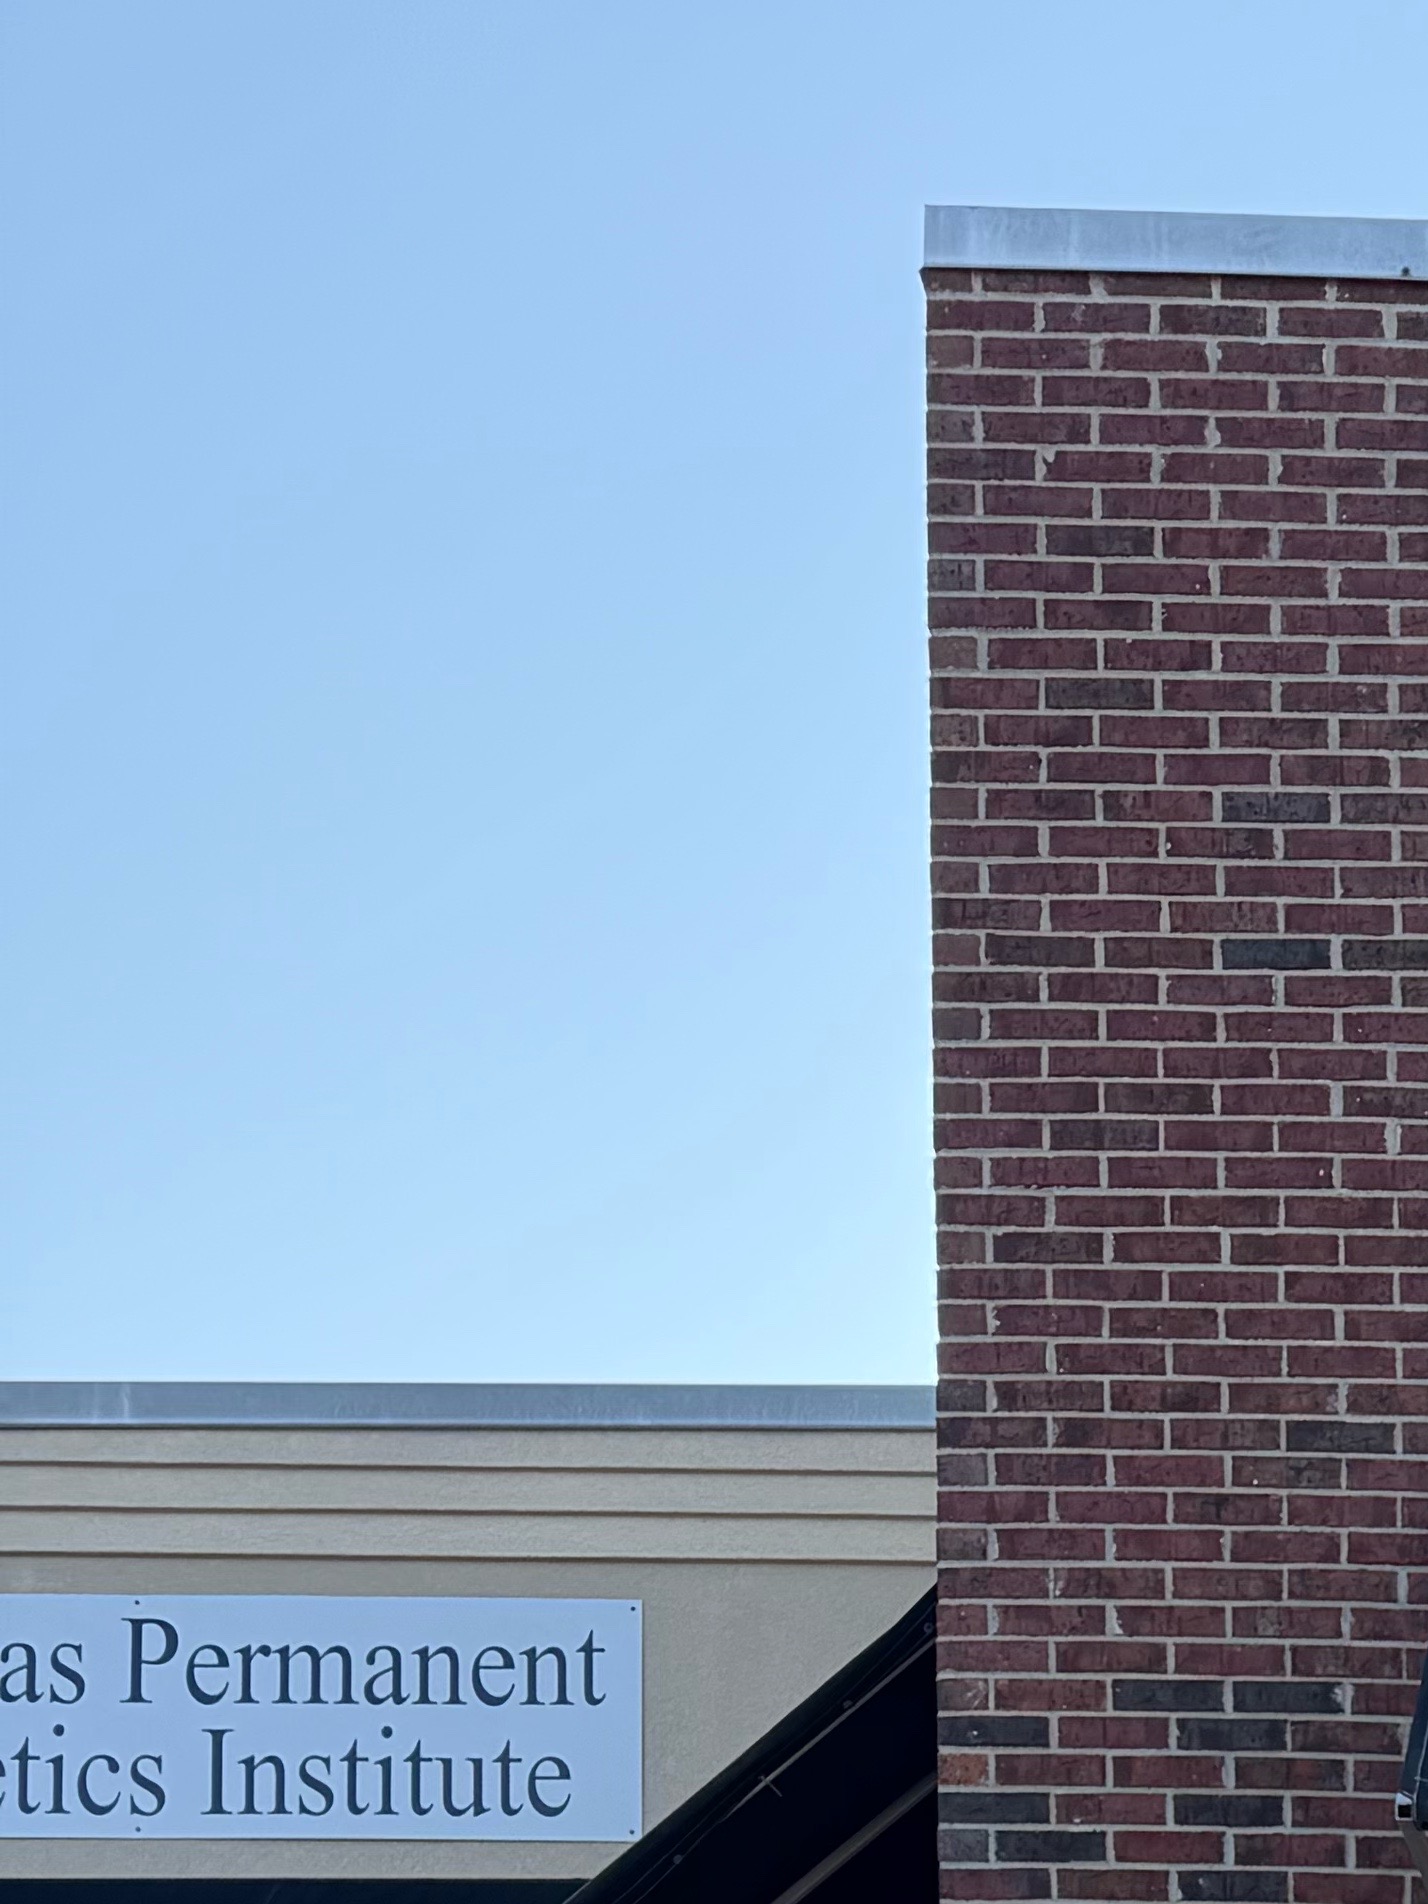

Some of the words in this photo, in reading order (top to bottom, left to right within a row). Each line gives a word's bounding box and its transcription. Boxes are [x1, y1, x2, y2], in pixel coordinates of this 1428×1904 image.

[119, 1617, 607, 1707] Permanent
[0, 1723, 166, 1817] tics
[200, 1724, 572, 1818] Institute
